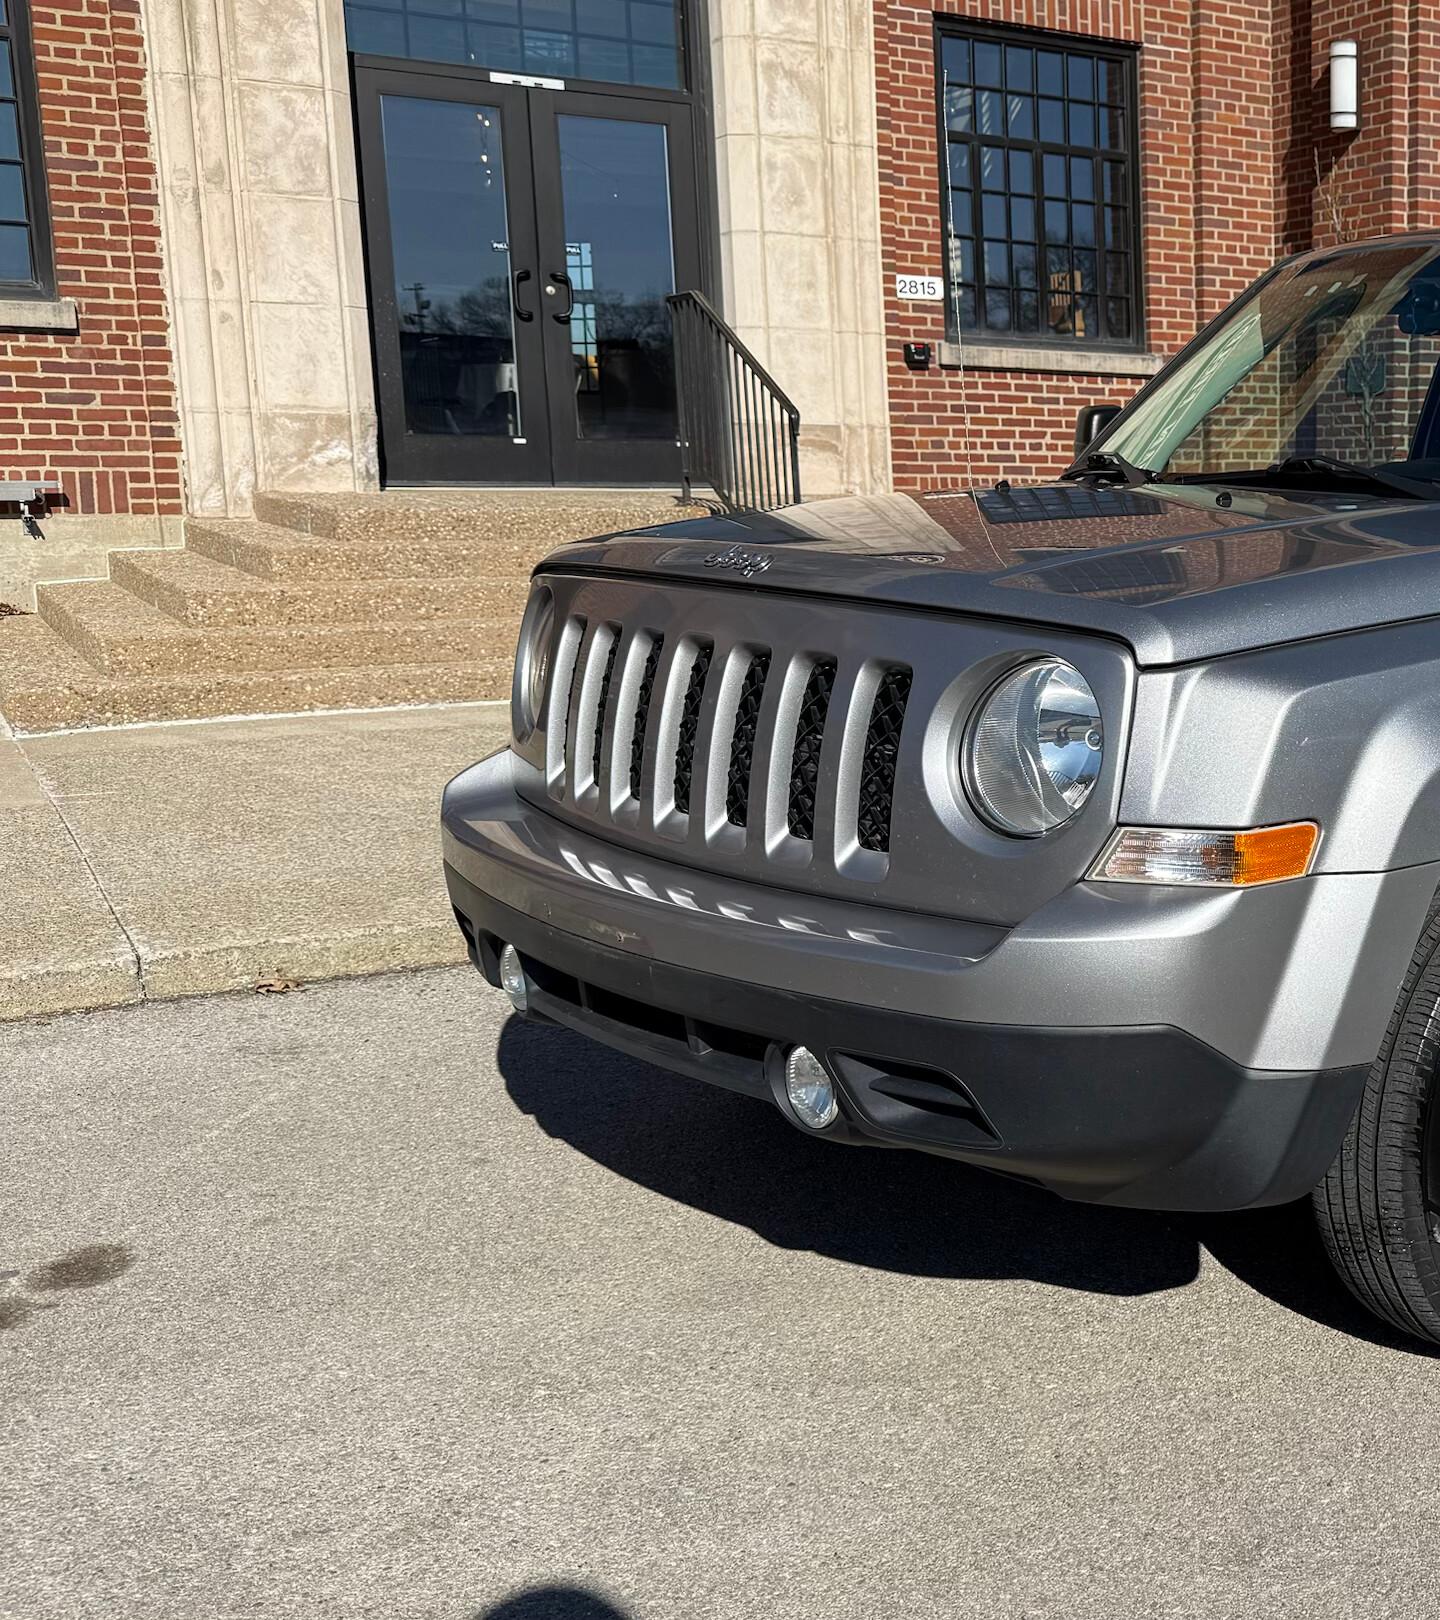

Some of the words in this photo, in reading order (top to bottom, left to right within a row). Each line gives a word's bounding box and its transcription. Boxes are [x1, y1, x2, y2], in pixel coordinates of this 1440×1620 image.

[492, 242, 509, 250] PULL
[565, 246, 581, 254] PULL
[898, 279, 936, 296] 2815
[703, 544, 776, 579] Jeep
